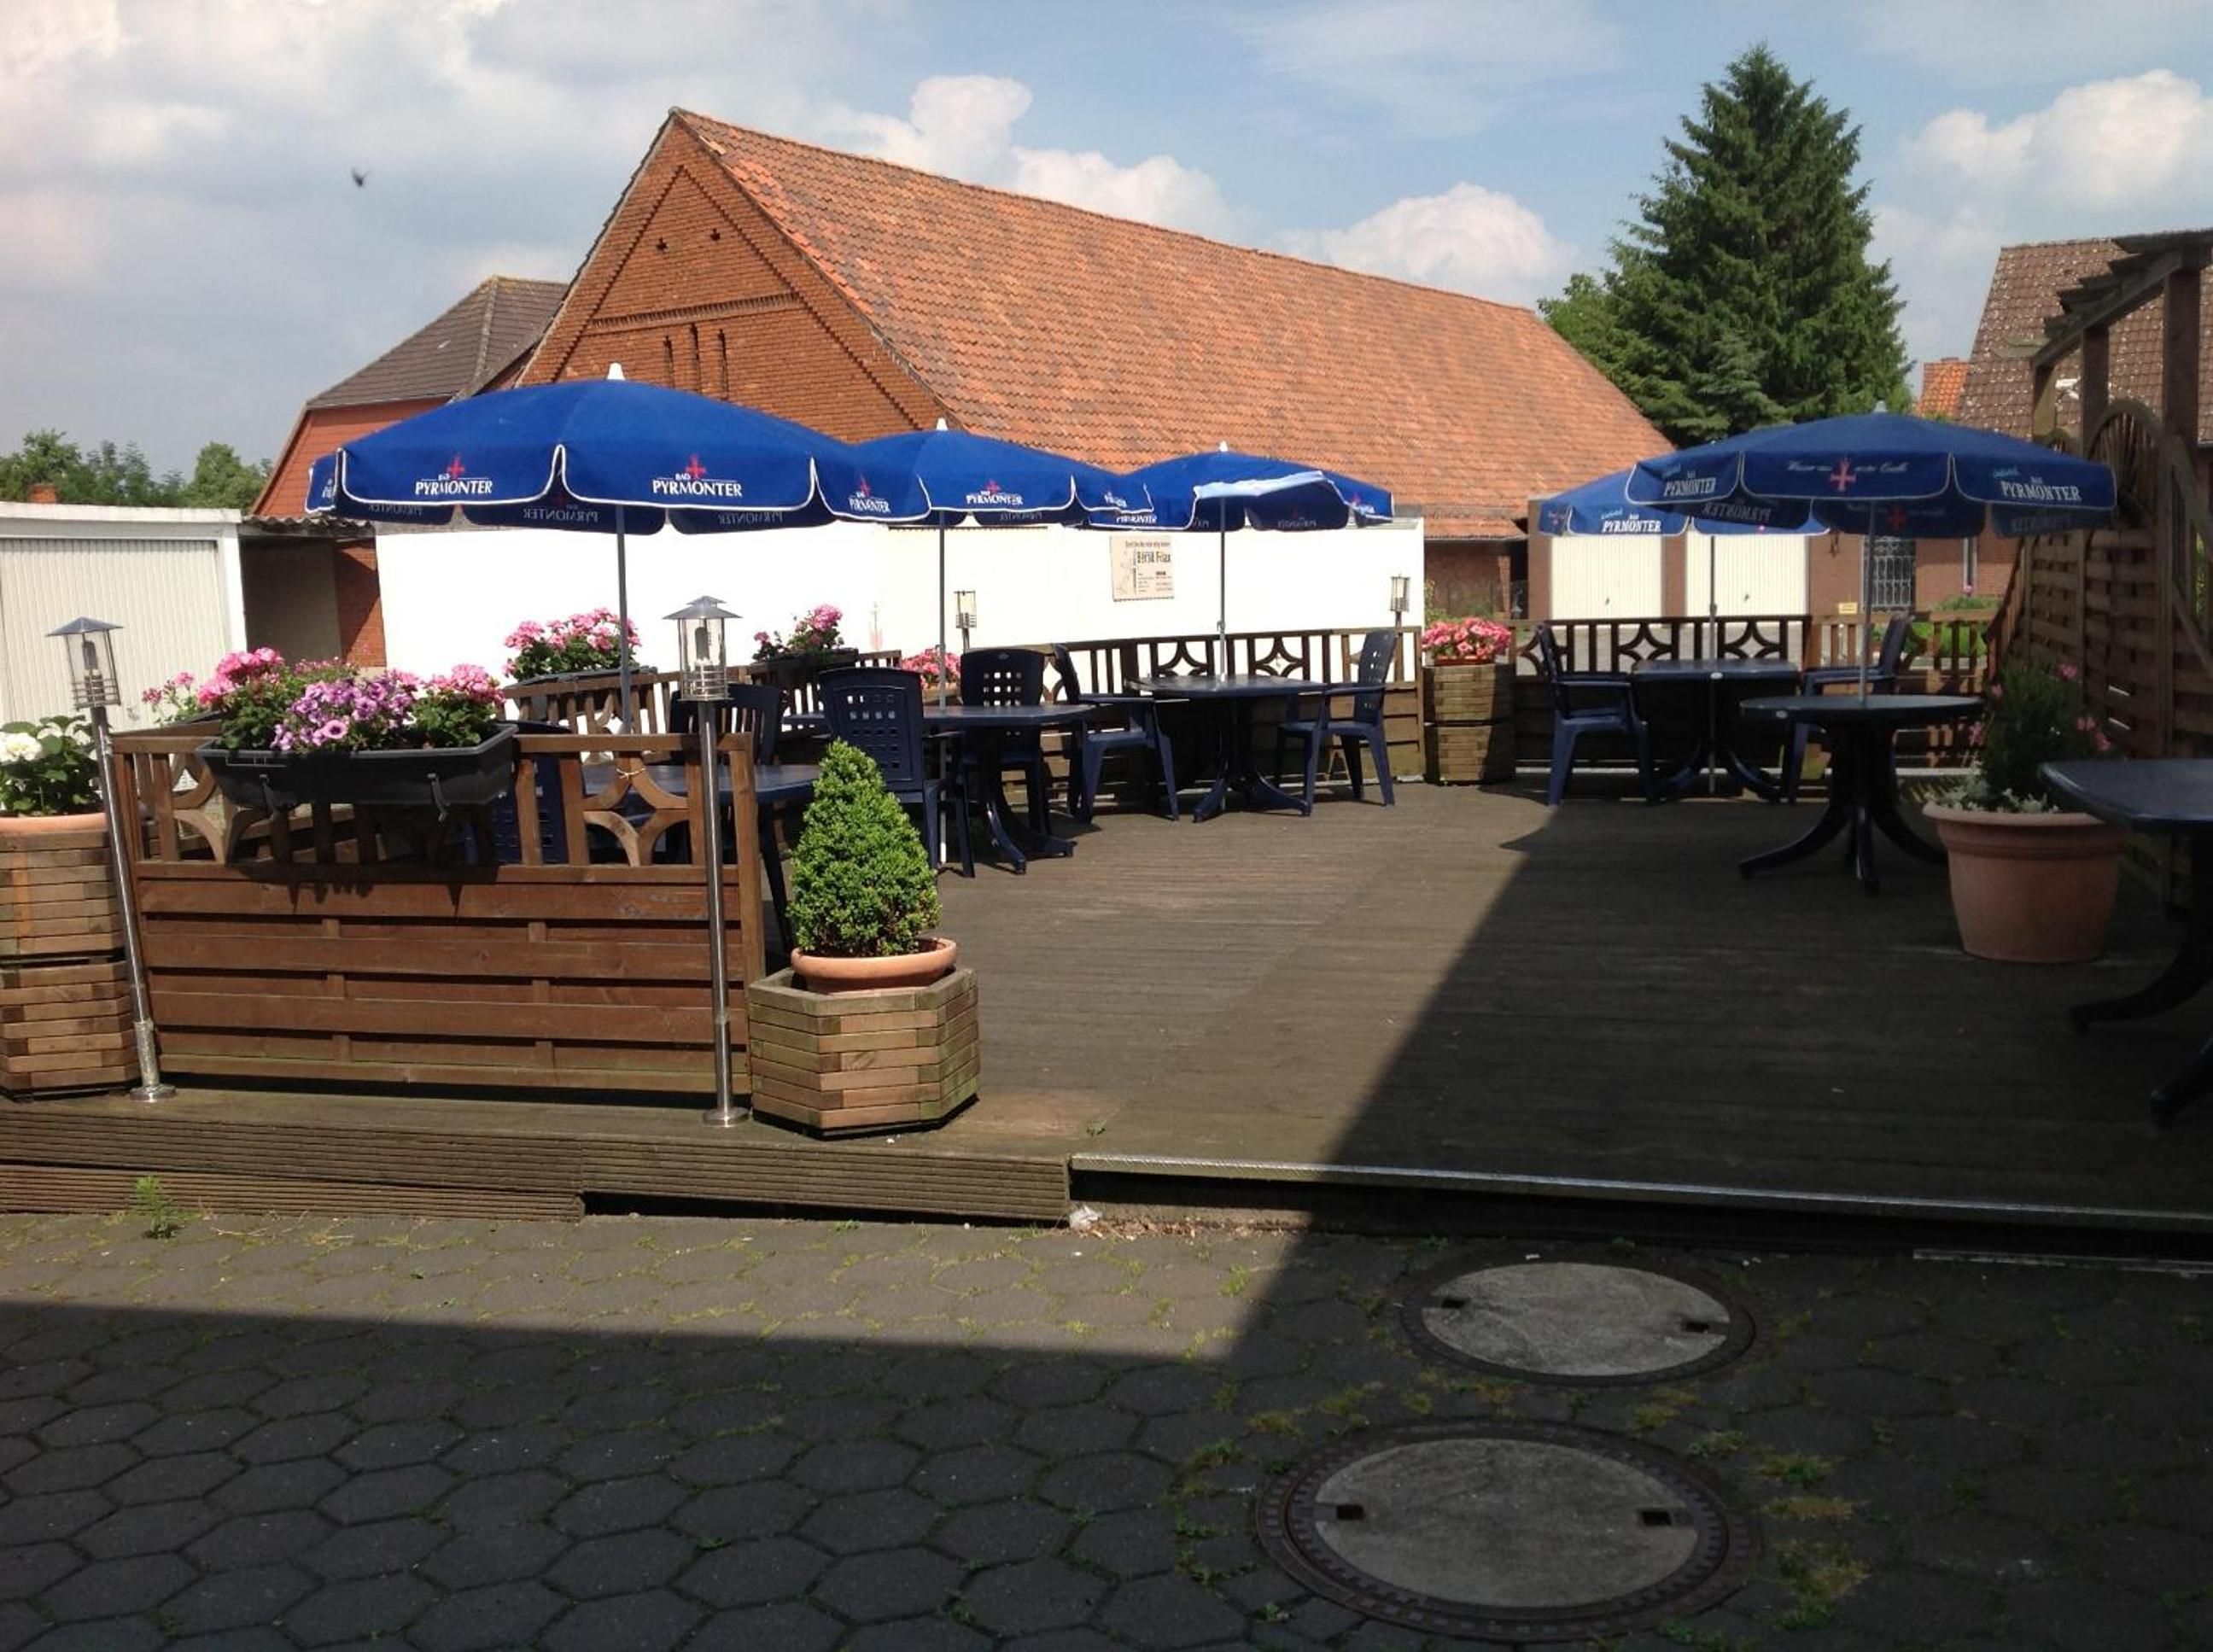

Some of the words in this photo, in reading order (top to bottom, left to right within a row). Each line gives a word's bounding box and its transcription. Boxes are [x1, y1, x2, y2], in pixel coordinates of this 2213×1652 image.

[415, 480, 493, 495] PYRMONTER
[652, 479, 743, 498] PYRMONTER
[1664, 477, 1716, 497] PYRMONTER
[2000, 480, 2082, 502] PYRMONTER
[1602, 519, 1661, 534] PYRMONTER
